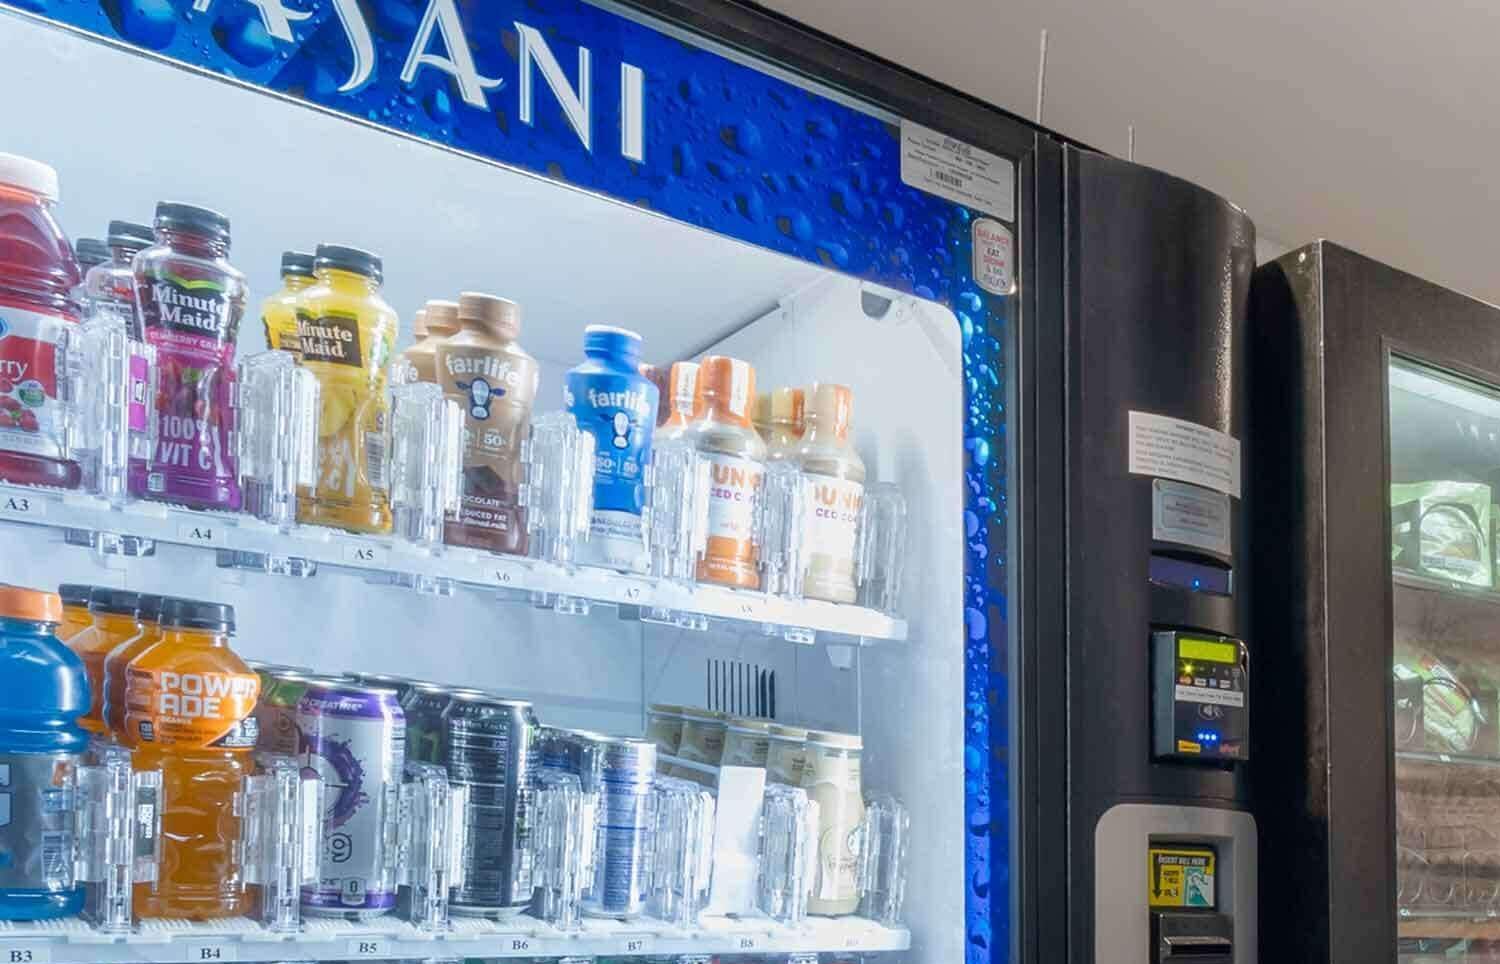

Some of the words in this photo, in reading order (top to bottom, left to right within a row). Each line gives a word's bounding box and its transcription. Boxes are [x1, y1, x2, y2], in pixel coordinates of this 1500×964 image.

[152, 283, 225, 314] Minute
[296, 319, 353, 342] Minute
[302, 337, 345, 359] Maid
[161, 441, 192, 467] VIT
[5, 498, 30, 512] A3
[190, 528, 212, 540] A4
[356, 549, 374, 560] A5
[495, 571, 511, 582] A6
[624, 588, 641, 599] A7
[160, 671, 257, 698] POWER
[160, 694, 221, 719] ADE
[359, 942, 377, 953] B5
[512, 940, 529, 951] B6
[627, 941, 643, 952] B7
[739, 938, 755, 949] B8
[10, 950, 33, 963] B3
[200, 947, 221, 960] B4
